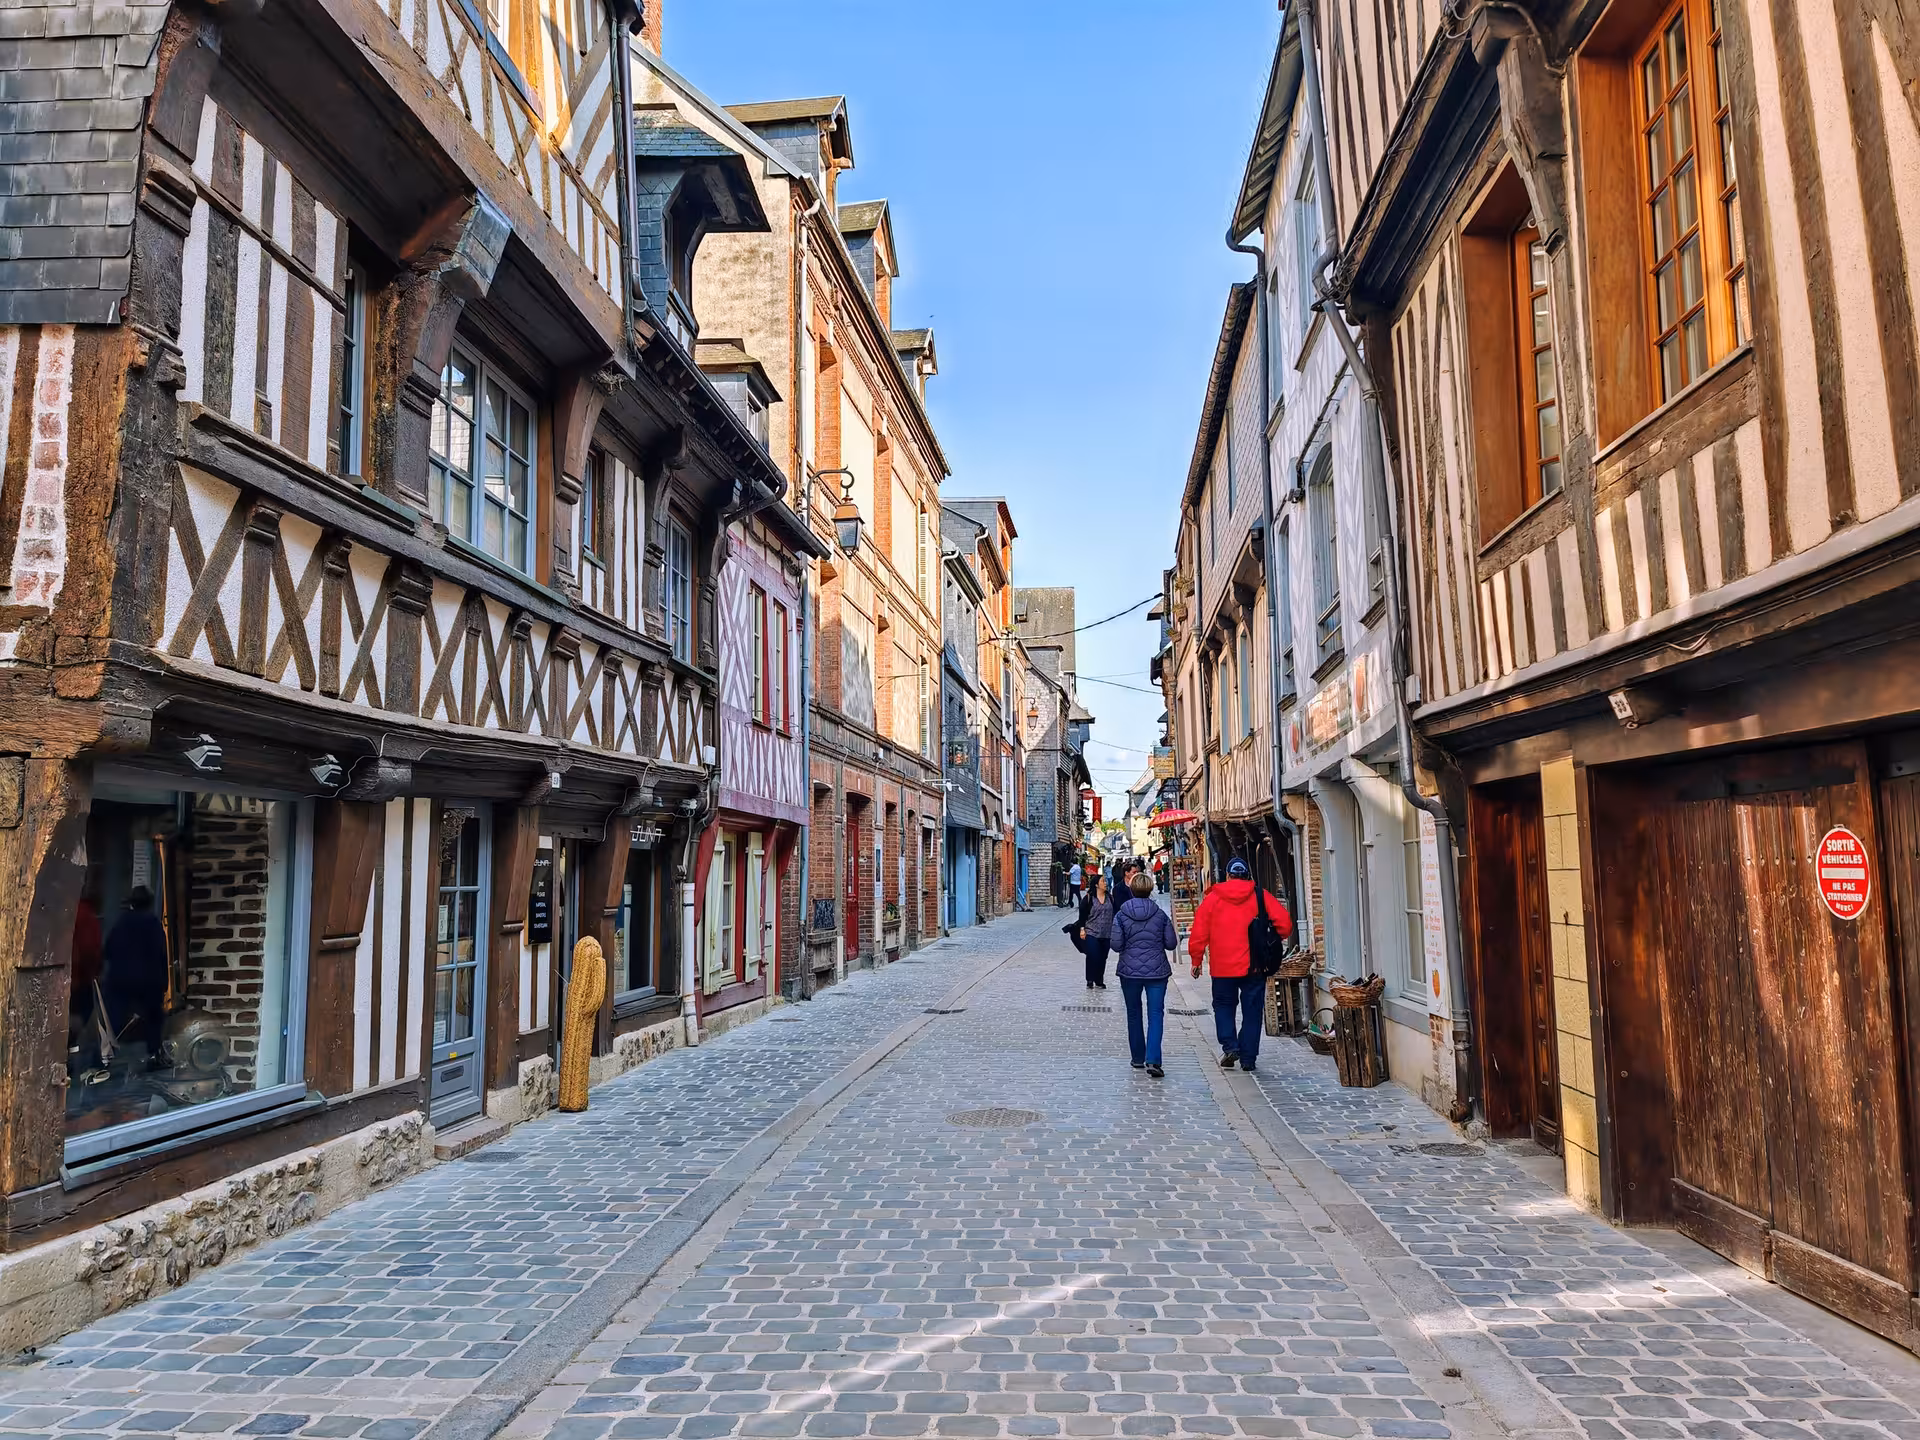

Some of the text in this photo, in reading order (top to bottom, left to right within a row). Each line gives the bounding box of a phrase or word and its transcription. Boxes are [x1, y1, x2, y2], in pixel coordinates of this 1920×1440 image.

[1826, 839, 1855, 851] SORTIE
[1832, 882, 1856, 891] NE PAS
[1826, 892, 1863, 902] STATIONNER
